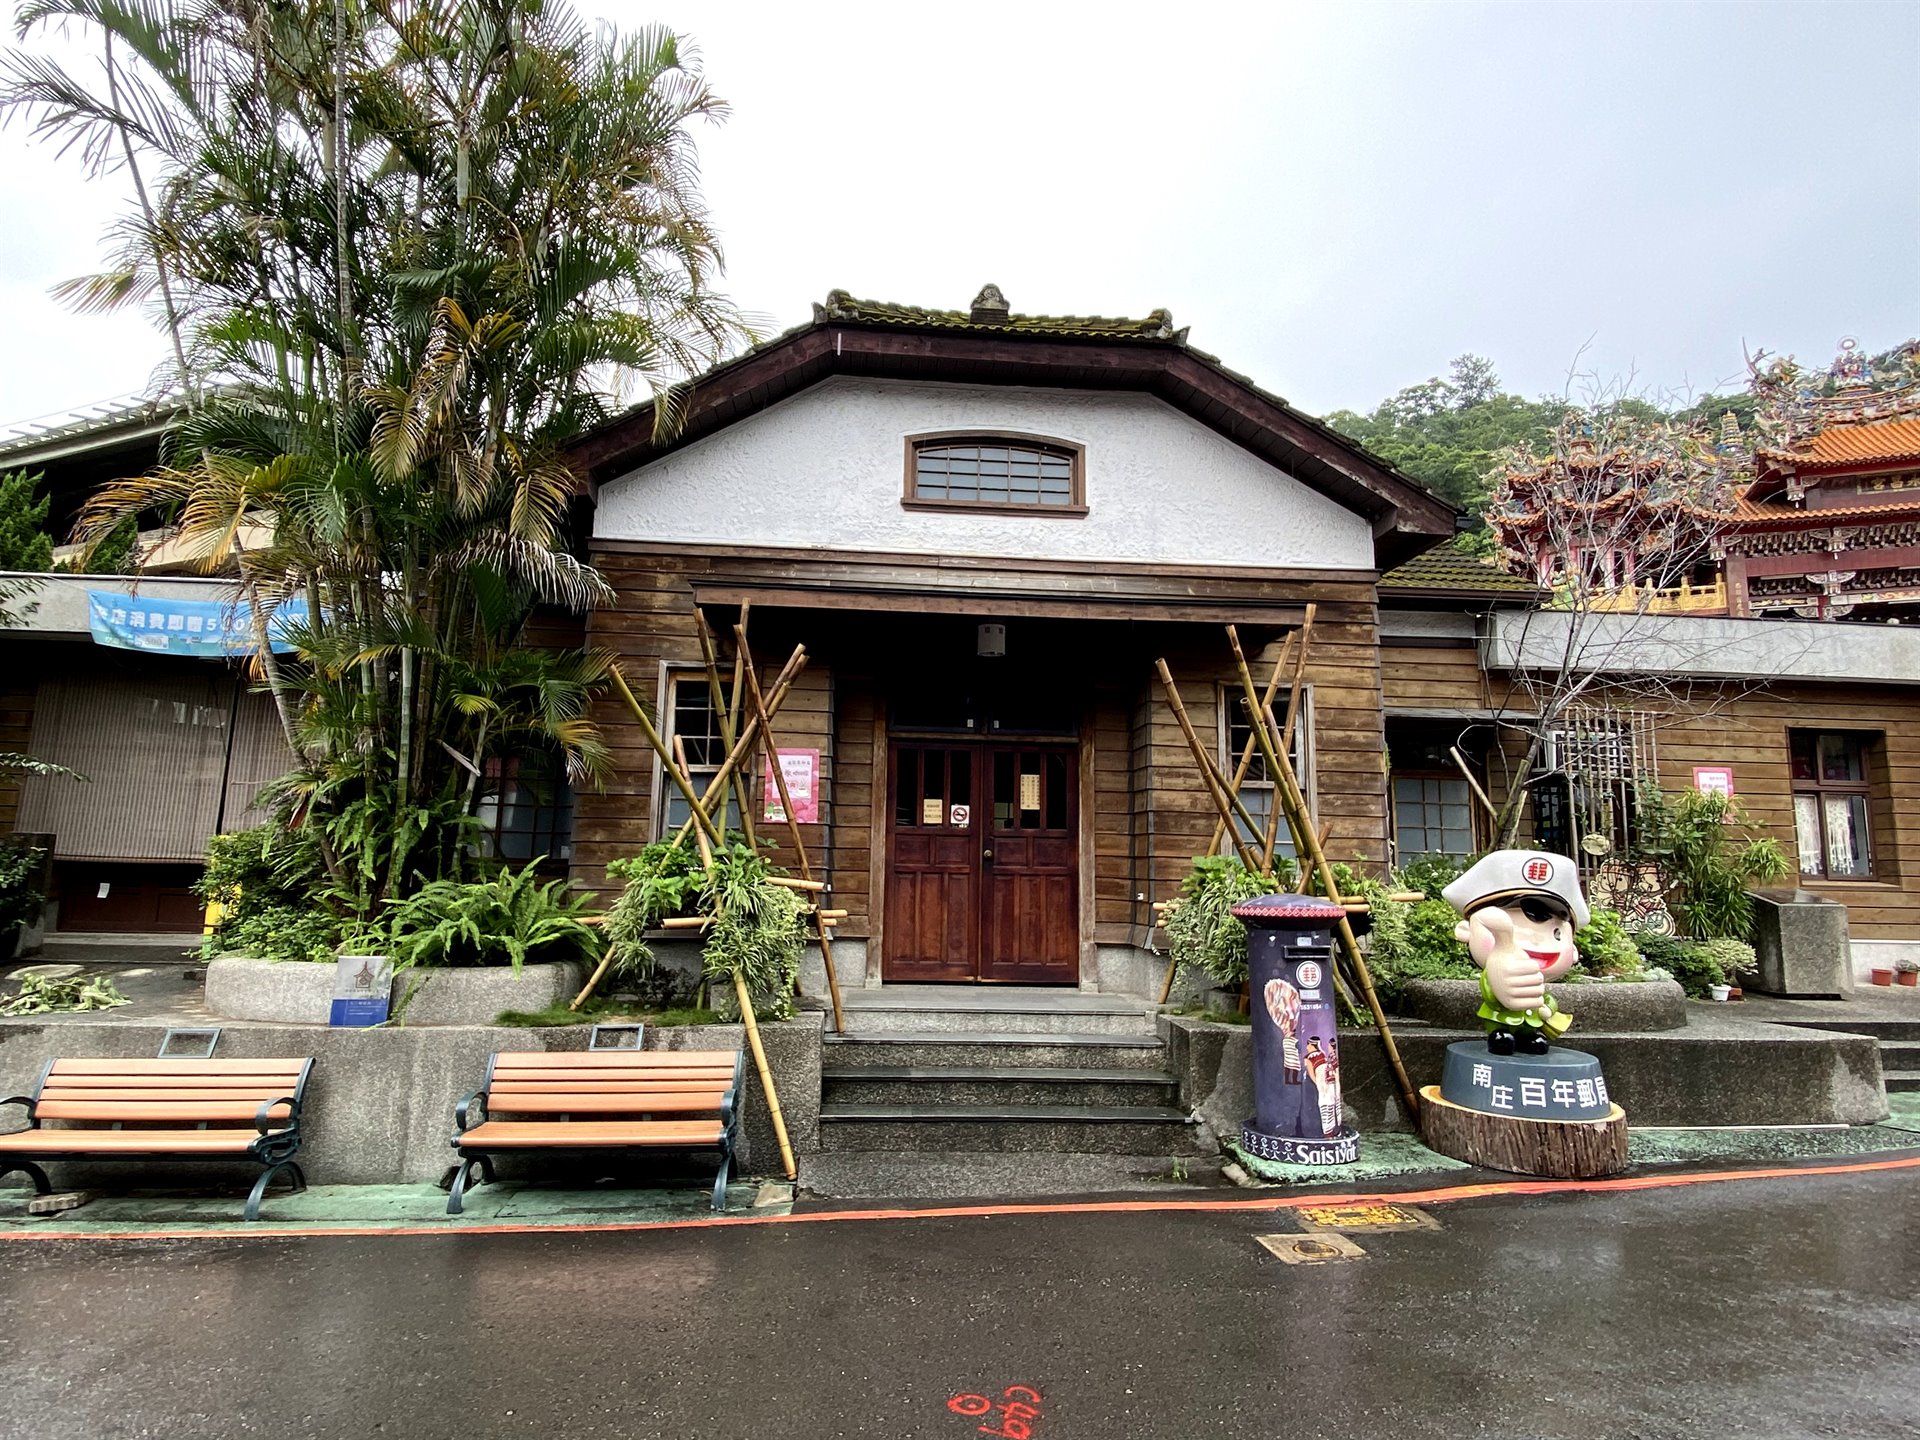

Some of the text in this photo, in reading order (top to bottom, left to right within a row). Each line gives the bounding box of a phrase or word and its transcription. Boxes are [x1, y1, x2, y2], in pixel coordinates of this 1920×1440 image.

[1527, 862, 1548, 881] 郵
[1472, 1063, 1609, 1110] 南庄百年郵局
[1296, 1143, 1357, 1165] Saisiyat
